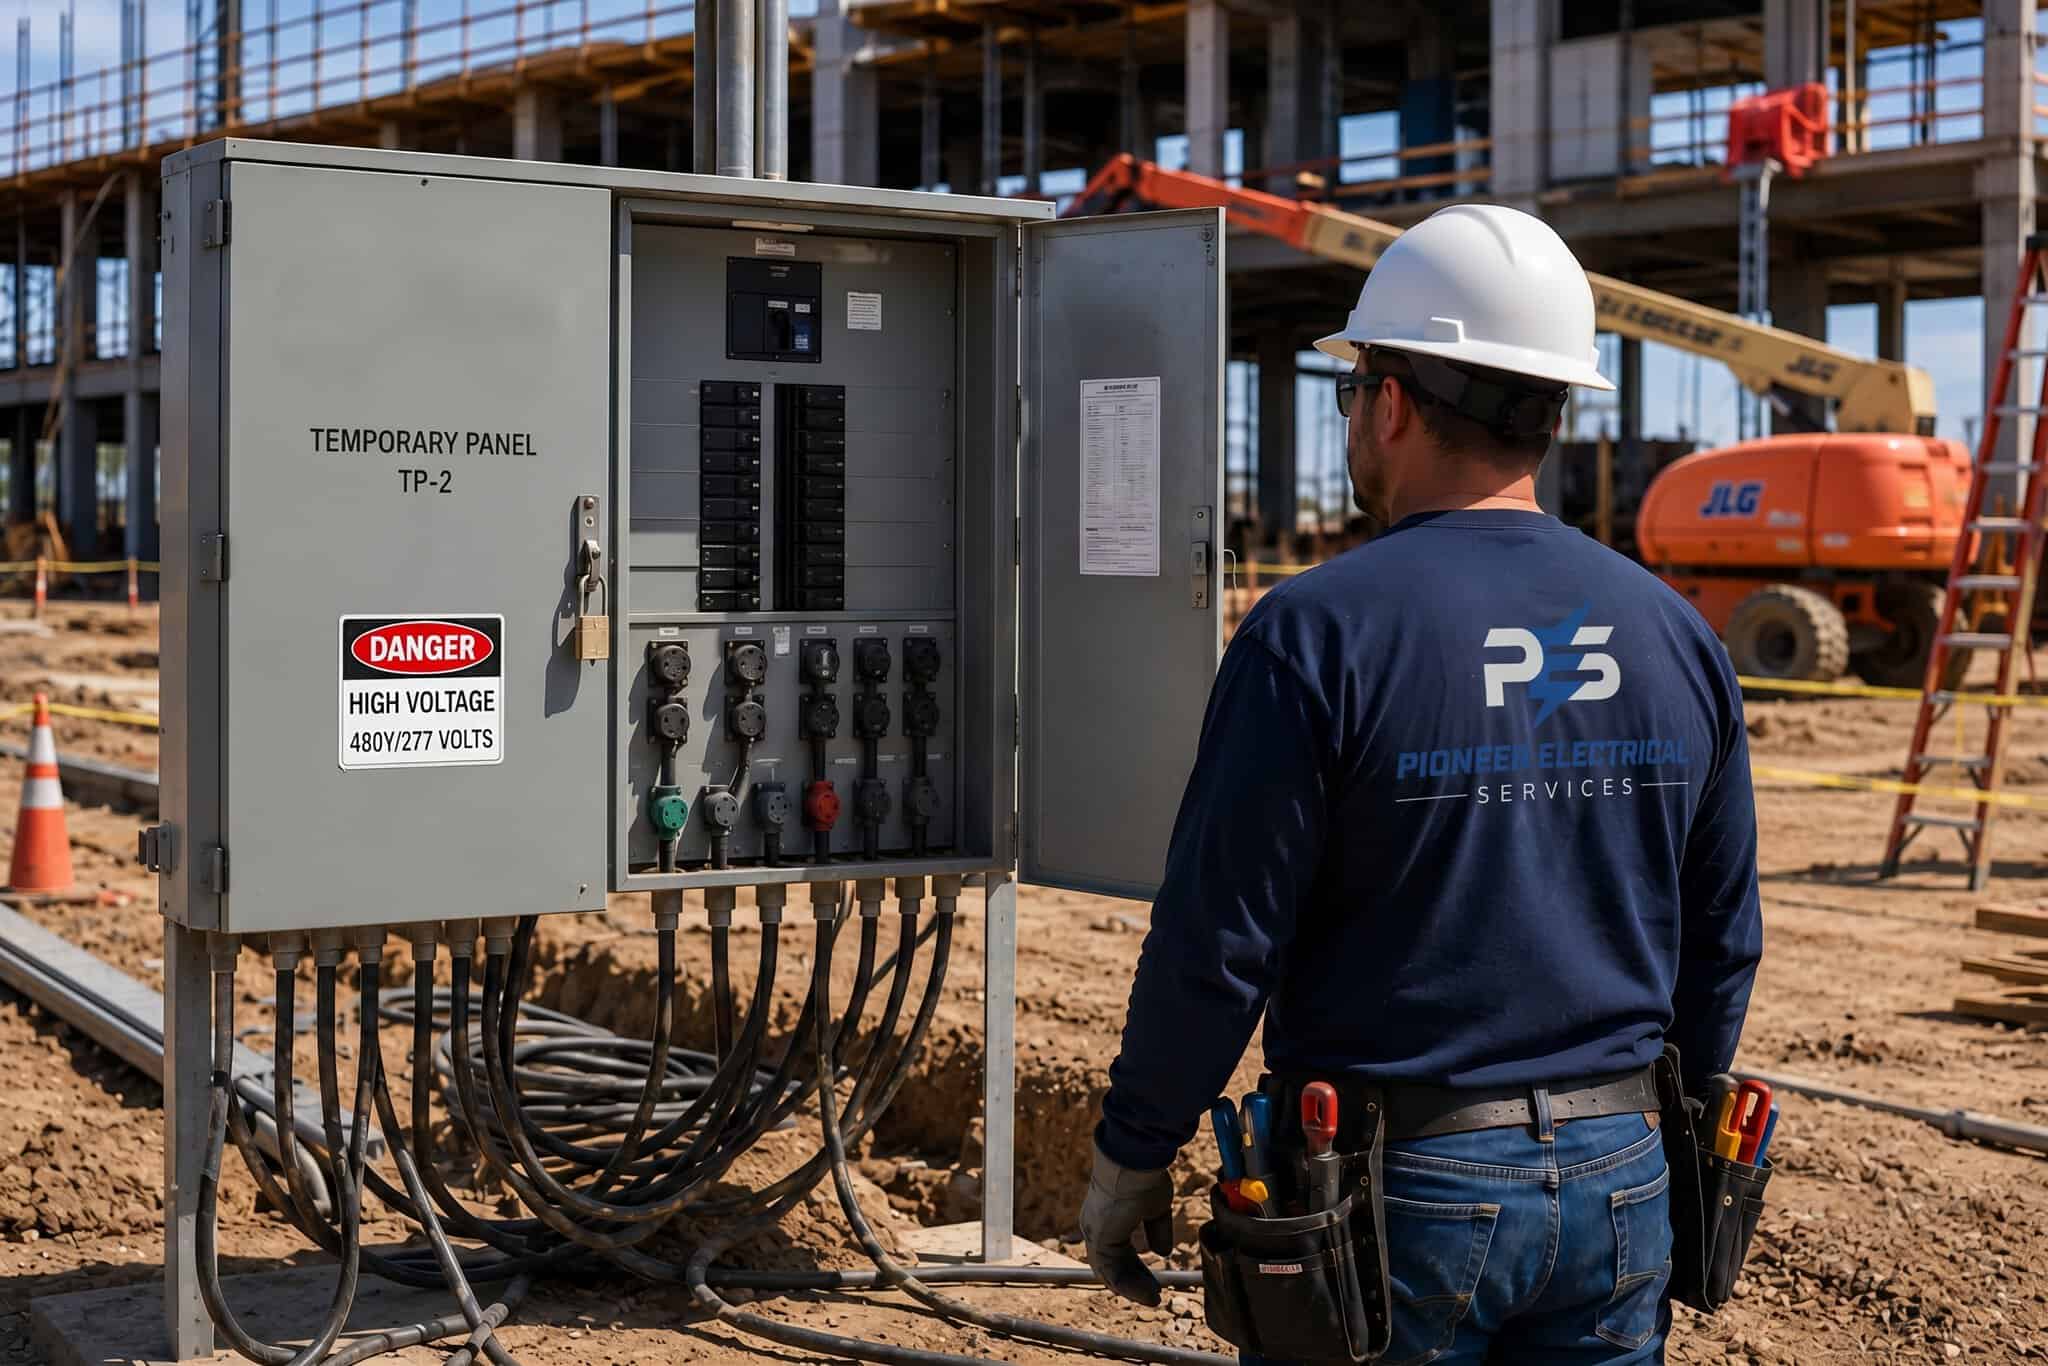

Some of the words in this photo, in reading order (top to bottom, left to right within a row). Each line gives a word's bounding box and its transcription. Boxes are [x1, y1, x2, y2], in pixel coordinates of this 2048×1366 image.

[310, 428, 458, 454] TEMPORARY
[466, 432, 537, 456] PANEL
[398, 469, 453, 493] TP-2
[1700, 481, 1763, 517] JLG
[370, 634, 475, 661] DANGER
[349, 692, 400, 714] HIGH
[407, 690, 495, 713] VOLTAGE
[350, 731, 433, 752] 480Y/277
[439, 729, 493, 749] VOLTS
[1538, 740, 1689, 768] ELECTRICAL
[1477, 778, 1633, 804] SERVICES
